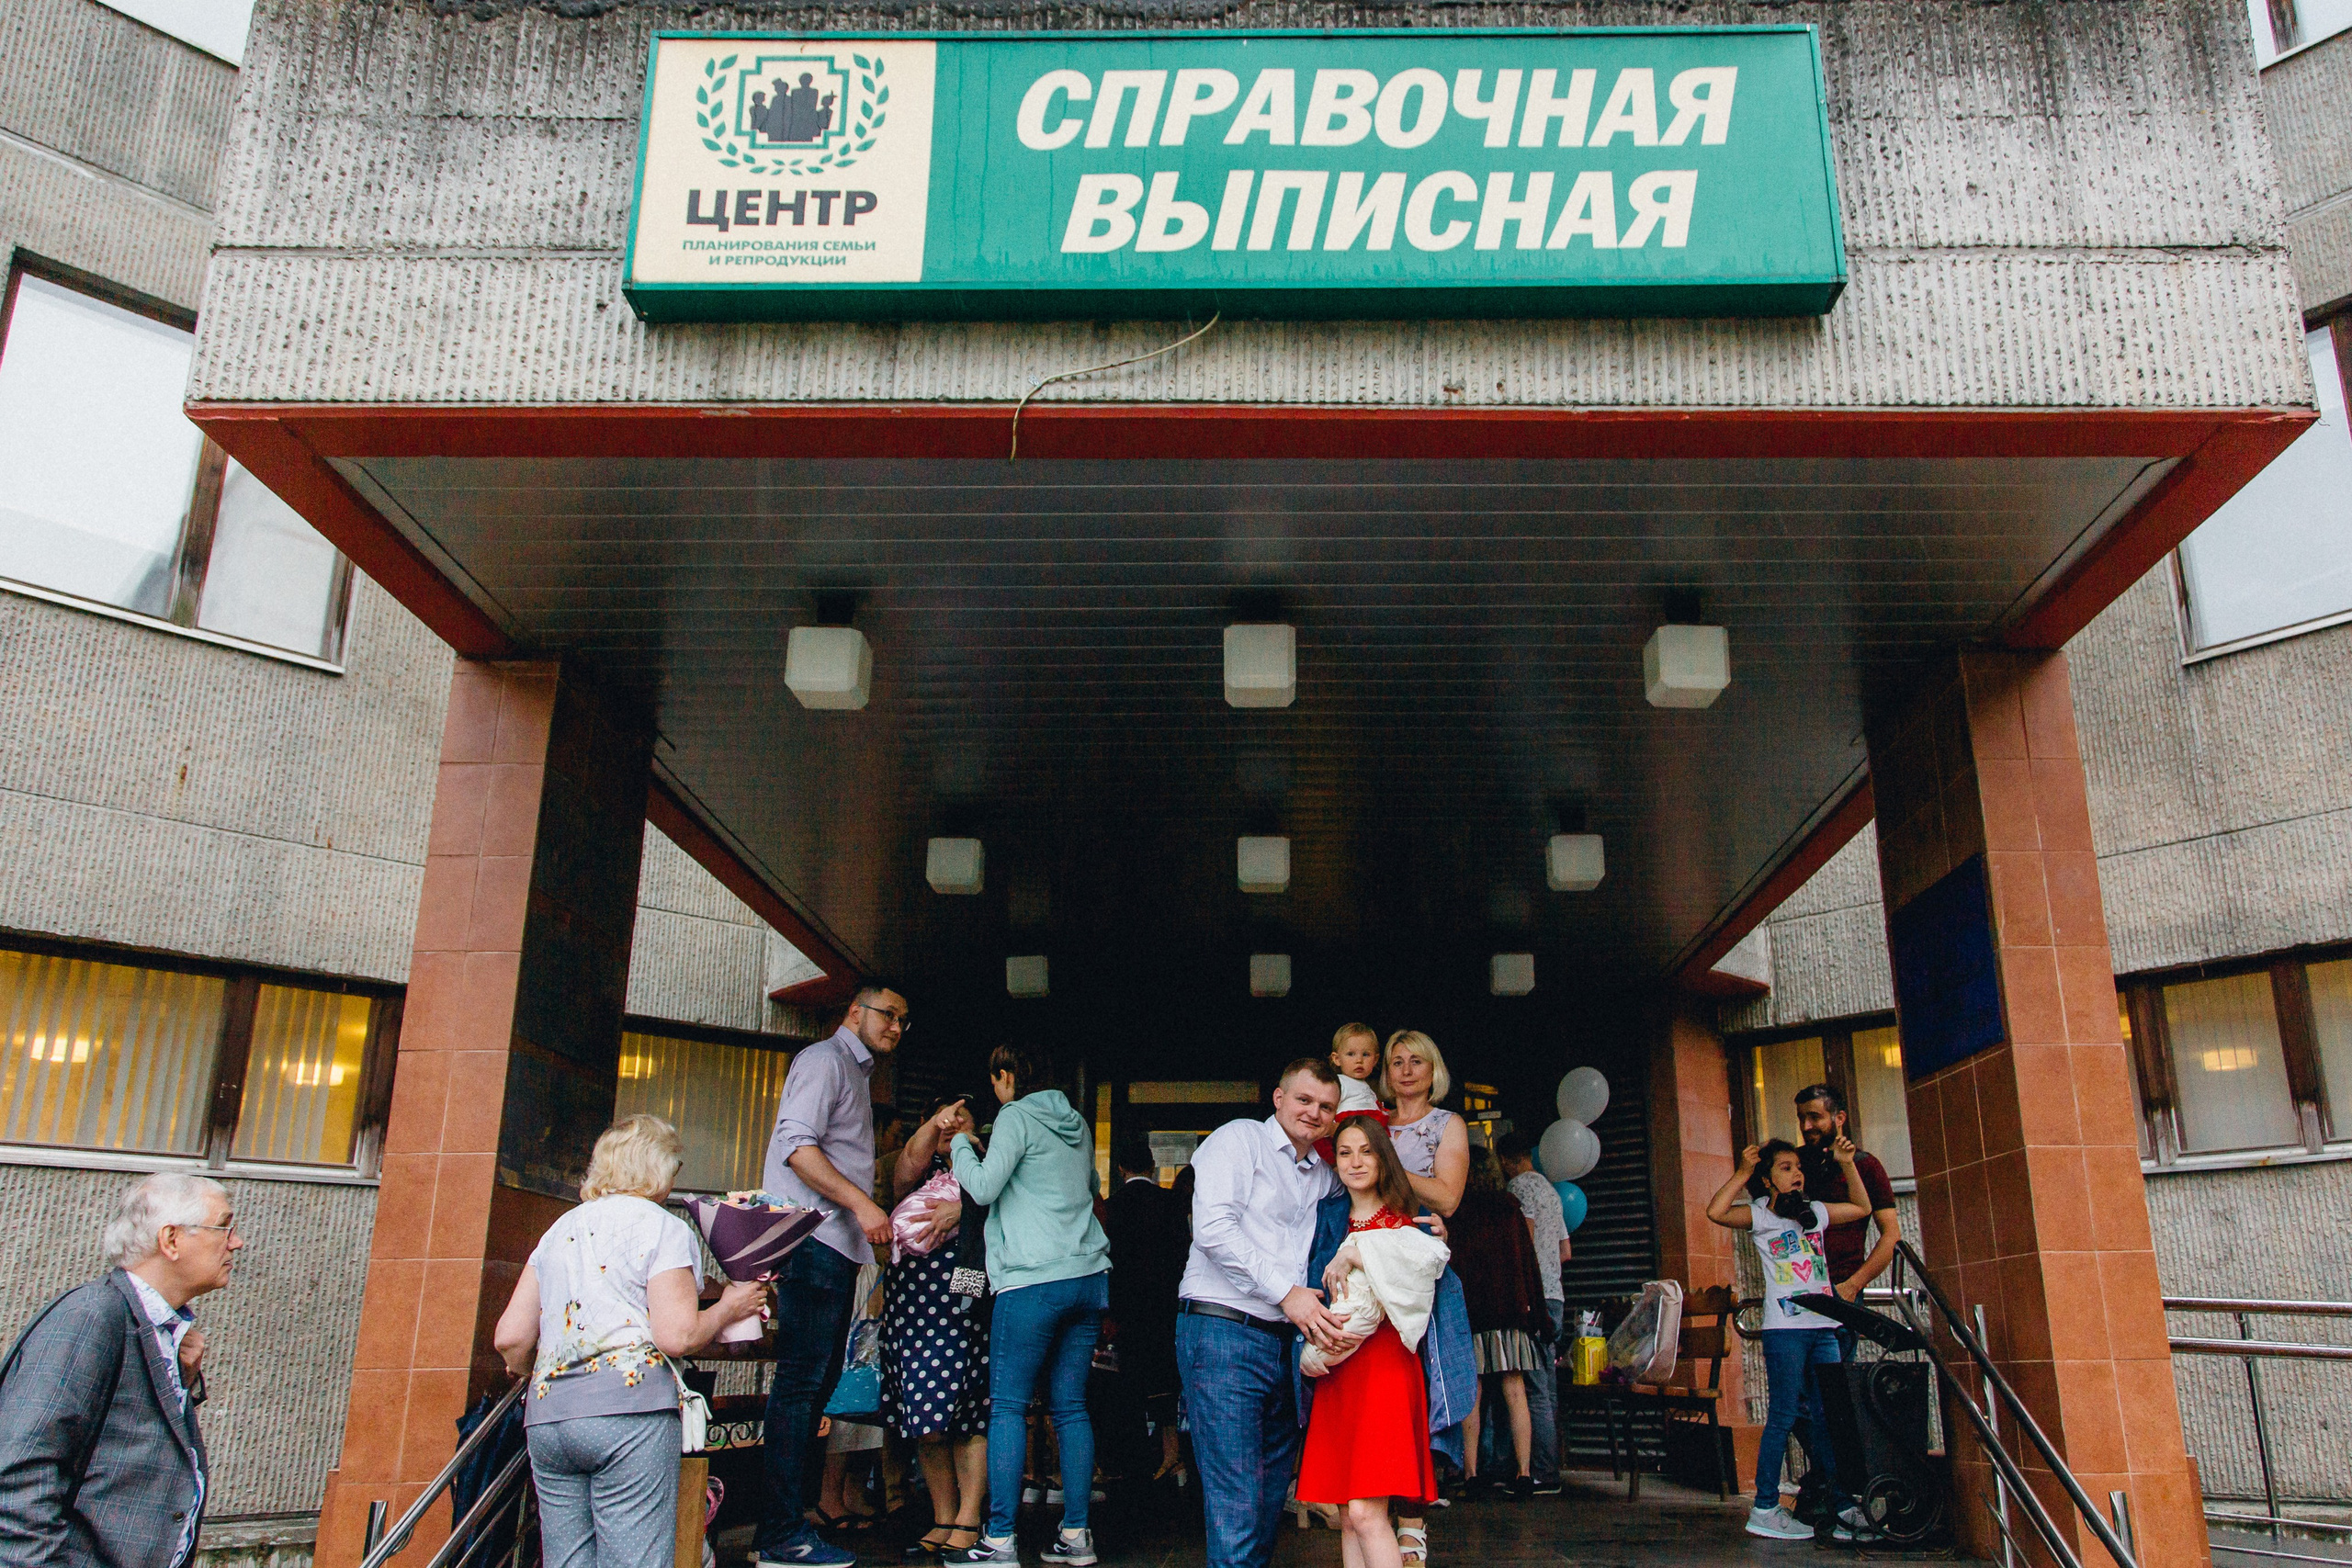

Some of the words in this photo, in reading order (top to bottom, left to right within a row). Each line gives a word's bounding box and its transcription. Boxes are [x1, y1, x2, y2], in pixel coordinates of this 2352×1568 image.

[1016, 65, 1739, 152] СПРАВОЧНАЯ
[685, 189, 878, 232] ЦЕНТР
[1059, 168, 1699, 254] ВЫПИСНАЯ
[682, 240, 819, 251] ПЛАНИРОВАНИЯ
[822, 240, 876, 251] СЕМЬИ
[708, 254, 721, 265] И
[724, 254, 847, 267] РЕПРОДУКЦИИ
